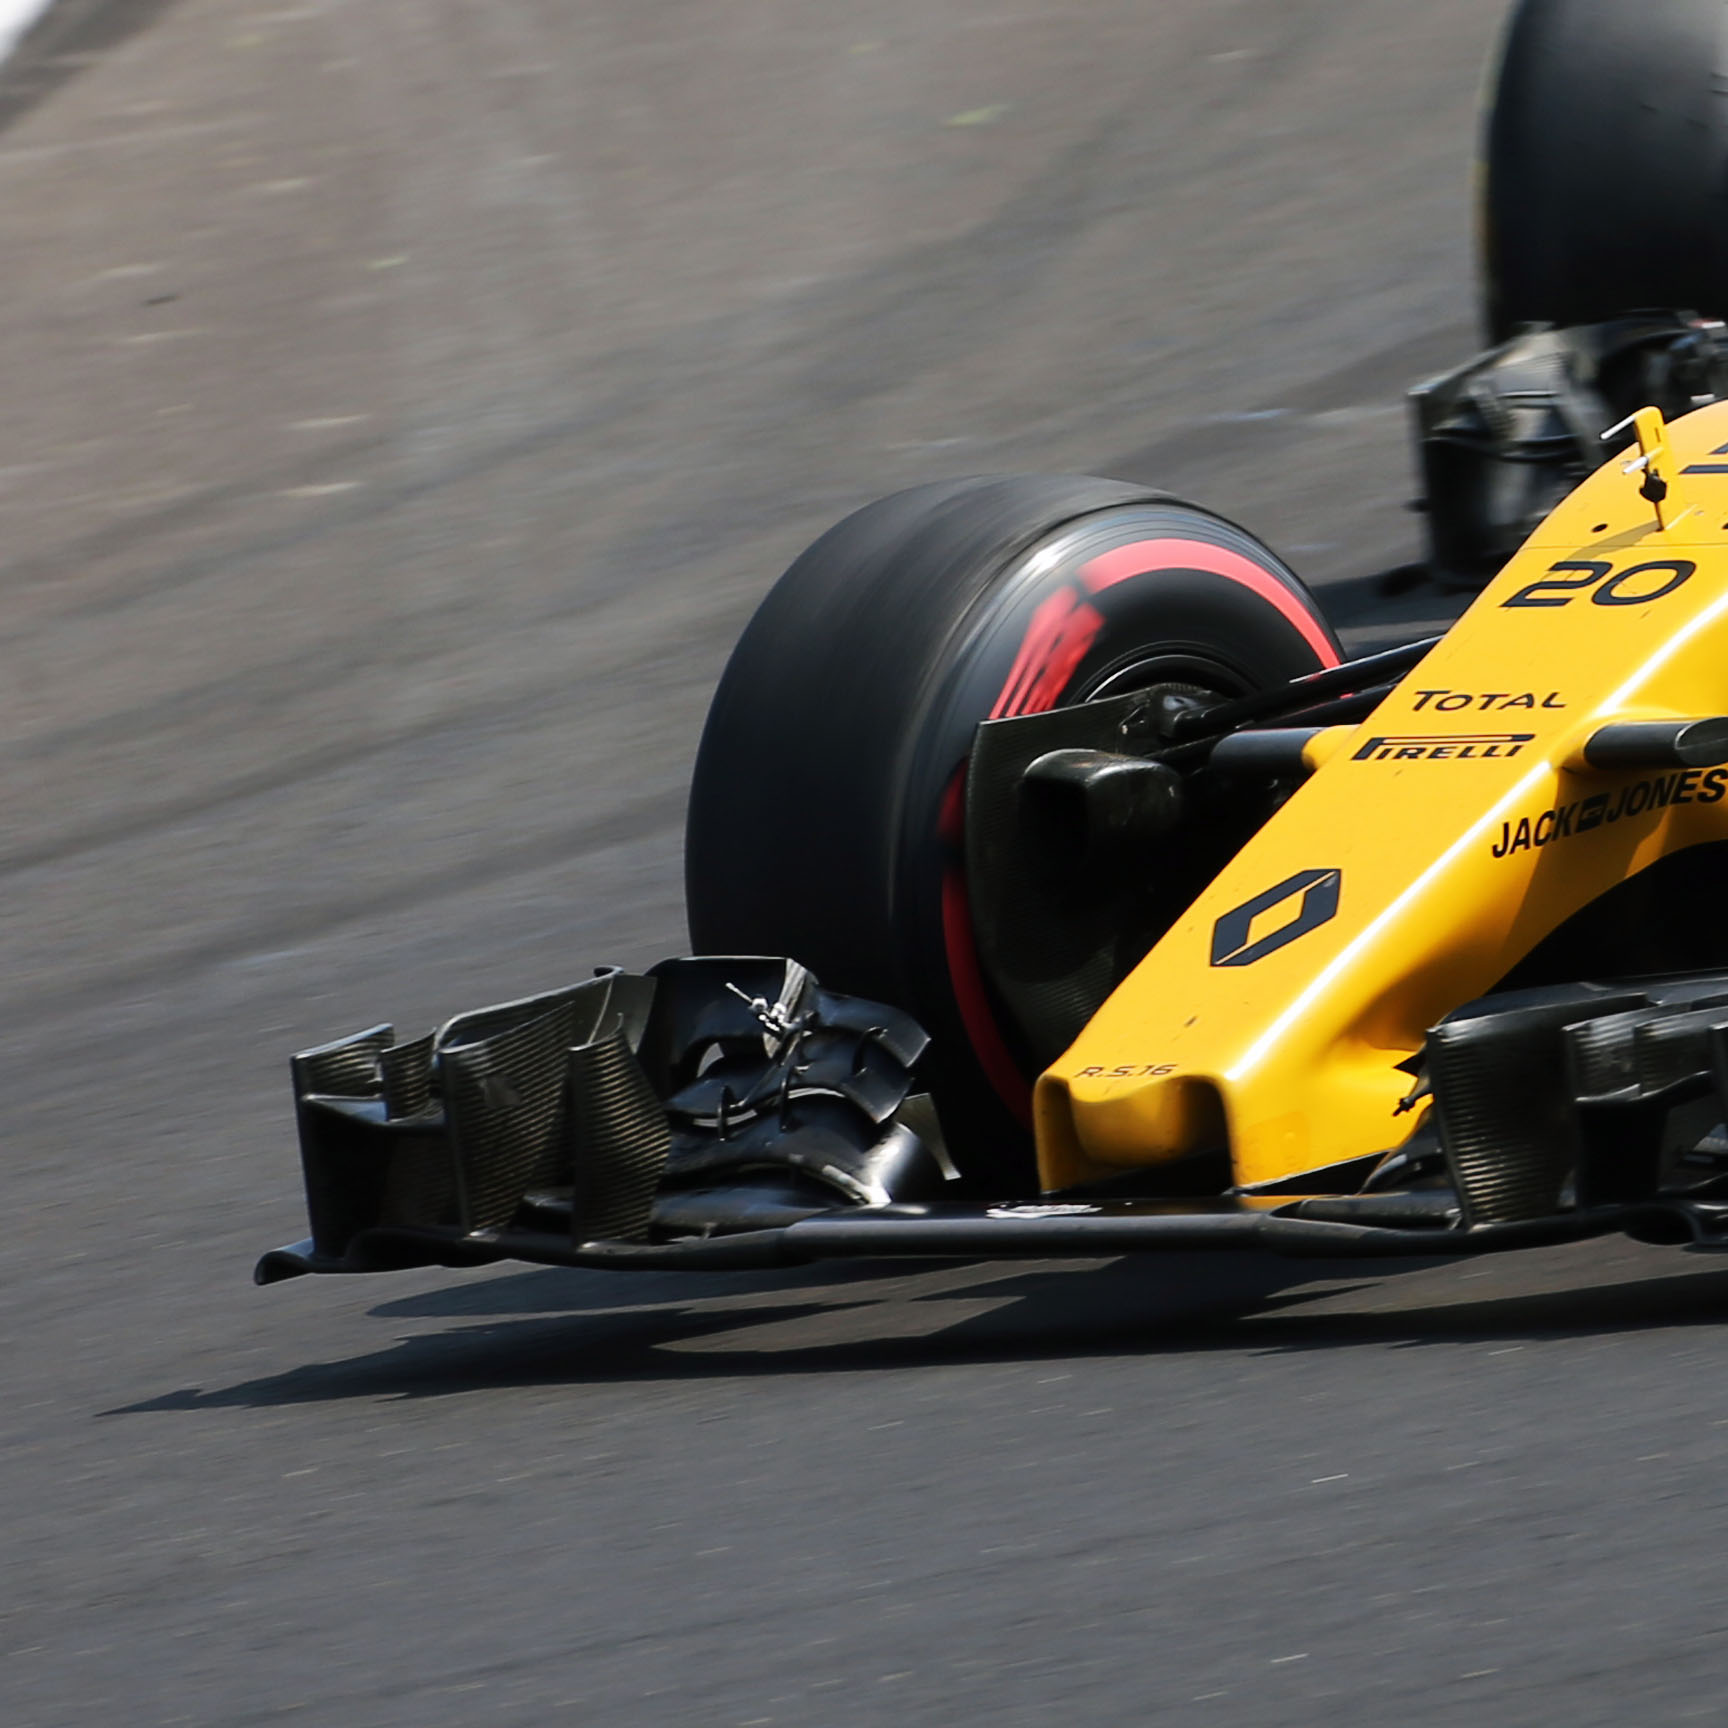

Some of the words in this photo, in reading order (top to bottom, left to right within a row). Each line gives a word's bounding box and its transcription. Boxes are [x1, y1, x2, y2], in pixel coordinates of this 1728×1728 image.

[1499, 558, 1697, 609] 20
[1412, 689, 1568, 712] TOTAL
[1350, 733, 1537, 761] PIRELLI
[1491, 800, 1581, 859] JACK
[1074, 1063, 1179, 1079] R.S.16
